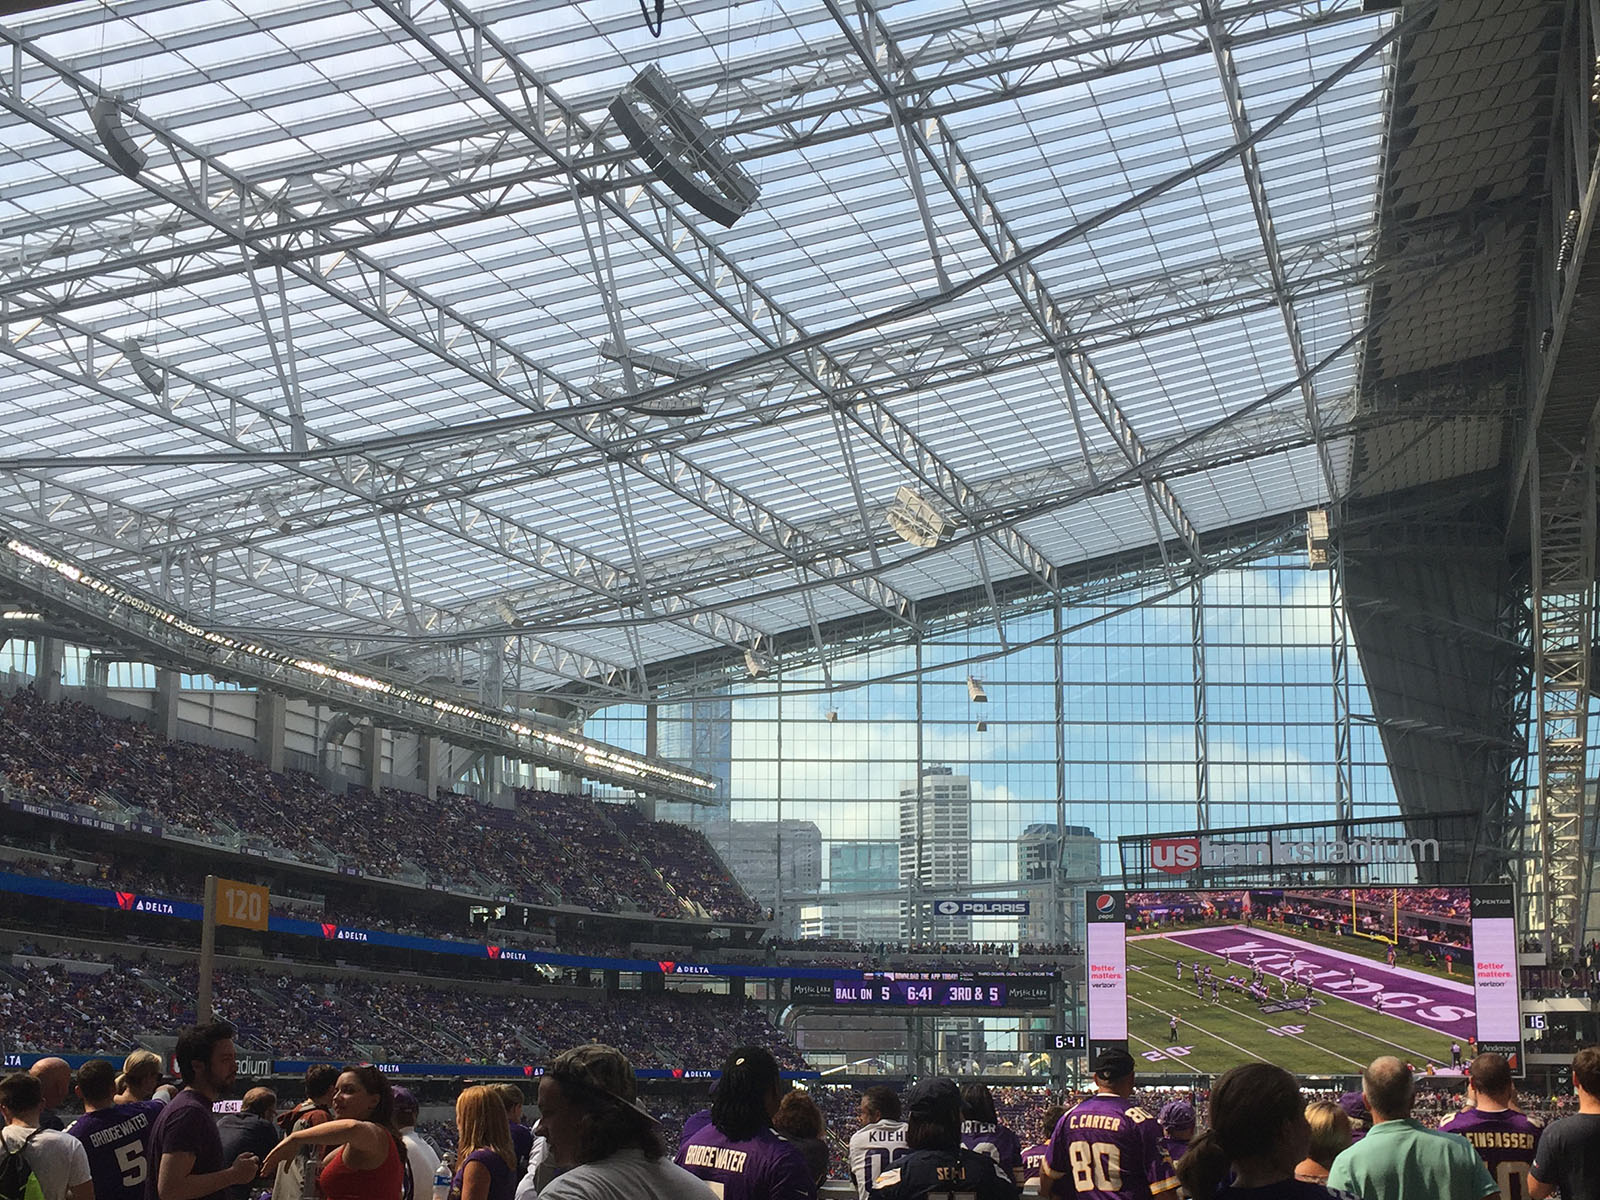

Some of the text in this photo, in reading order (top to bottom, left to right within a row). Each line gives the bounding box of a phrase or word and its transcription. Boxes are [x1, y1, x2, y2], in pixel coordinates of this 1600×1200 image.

[145, 901, 174, 914] DELTA
[225, 888, 262, 921] 120
[962, 904, 1026, 913] POLARIS
[344, 931, 368, 941] DELTA
[506, 952, 527, 961] DELTA
[684, 966, 710, 974] DELTA
[1216, 941, 1477, 1023] VIKINGS
[836, 988, 857, 999] BALL
[861, 988, 872, 999] ON
[882, 987, 890, 1000] 5
[908, 986, 932, 1000] 6:41
[949, 987, 998, 1000] 3RD & 5
[1530, 1016, 1545, 1028] 16
[1056, 1036, 1084, 1048] 6:41
[1482, 1044, 1516, 1052] Andersen
[4, 1055, 22, 1066] LTA
[235, 1055, 269, 1076] adium
[379, 1063, 400, 1073] DELTA
[690, 1070, 711, 1078] DELTA
[961, 1119, 996, 1134] RTER
[1069, 1114, 1121, 1131] C.CARTER
[89, 1113, 149, 1148] BRIDGEWATER
[869, 1131, 907, 1142] KUEH
[1466, 1130, 1534, 1149] EINSASSER
[115, 1139, 148, 1187] 5
[685, 1144, 747, 1173] BRIDGEWATER
[1027, 1155, 1045, 1169] PET
[1069, 1140, 1123, 1192] 80
